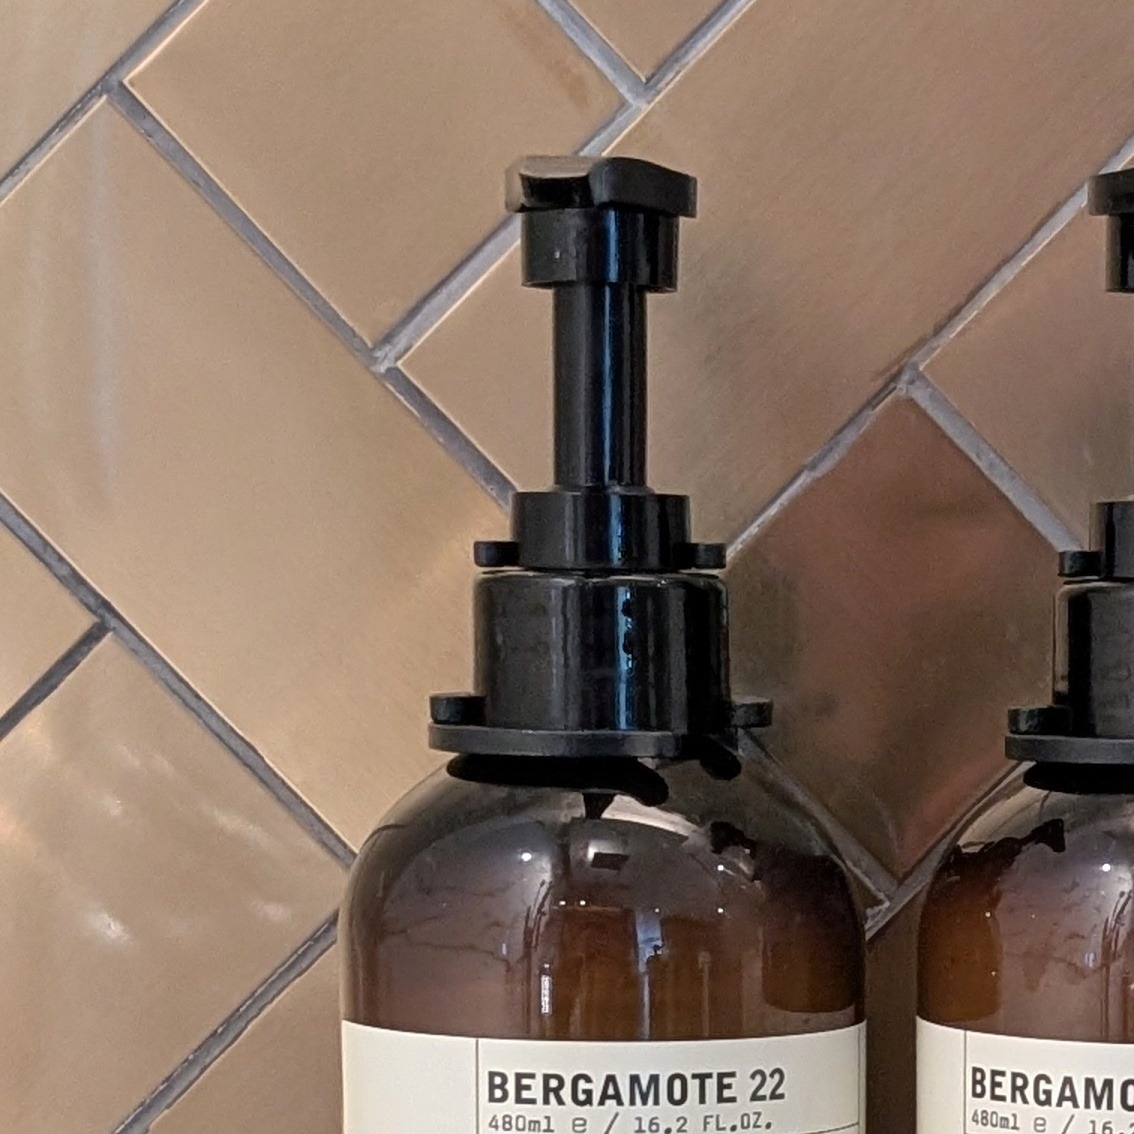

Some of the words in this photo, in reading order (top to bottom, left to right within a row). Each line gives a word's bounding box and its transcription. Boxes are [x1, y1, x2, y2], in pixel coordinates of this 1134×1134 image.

[488, 1071, 737, 1106] BERGAMOTE
[749, 1067, 785, 1102] 22
[488, 1114, 555, 1133] 480ml
[634, 1116, 687, 1134] 16.2
[703, 1111, 772, 1133] FL.OZ.
[972, 1109, 1020, 1131] 480ml
